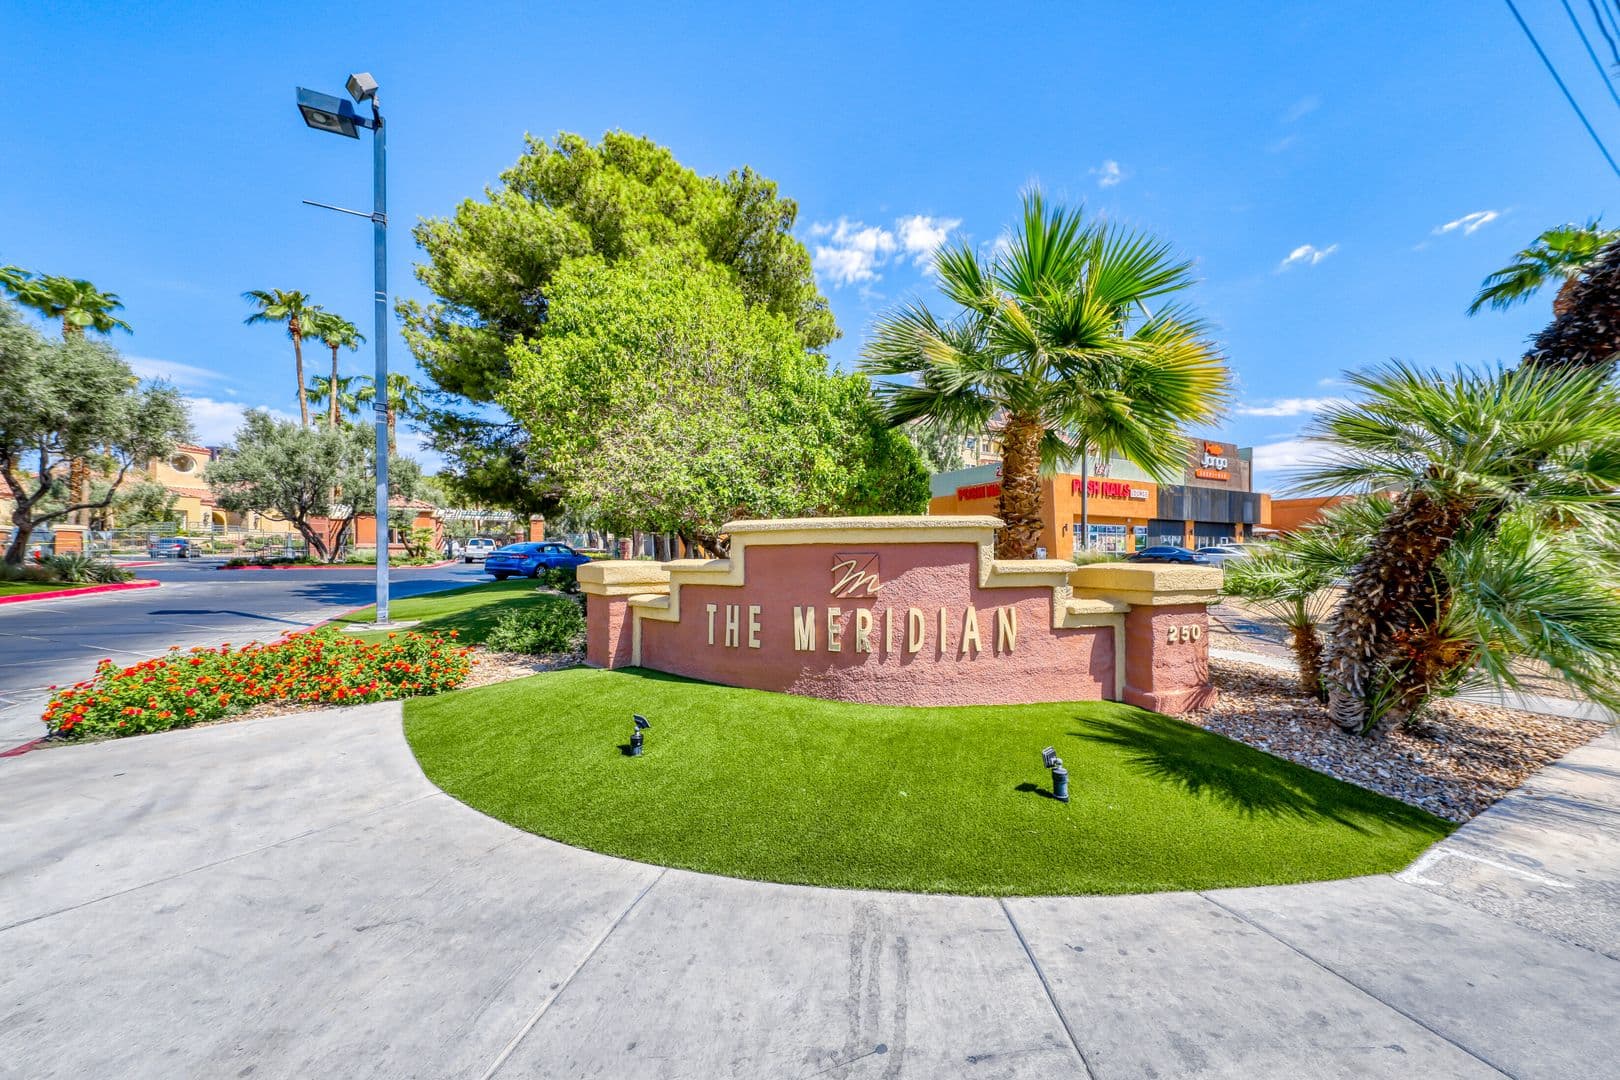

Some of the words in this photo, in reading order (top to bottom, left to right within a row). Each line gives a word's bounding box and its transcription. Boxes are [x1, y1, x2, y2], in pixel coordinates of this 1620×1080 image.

[1072, 479, 1100, 497] PSH
[1101, 481, 1130, 498] NAILS
[706, 603, 761, 648] THE
[793, 605, 1017, 654] MERIDIAN
[1168, 624, 1201, 641] 250
